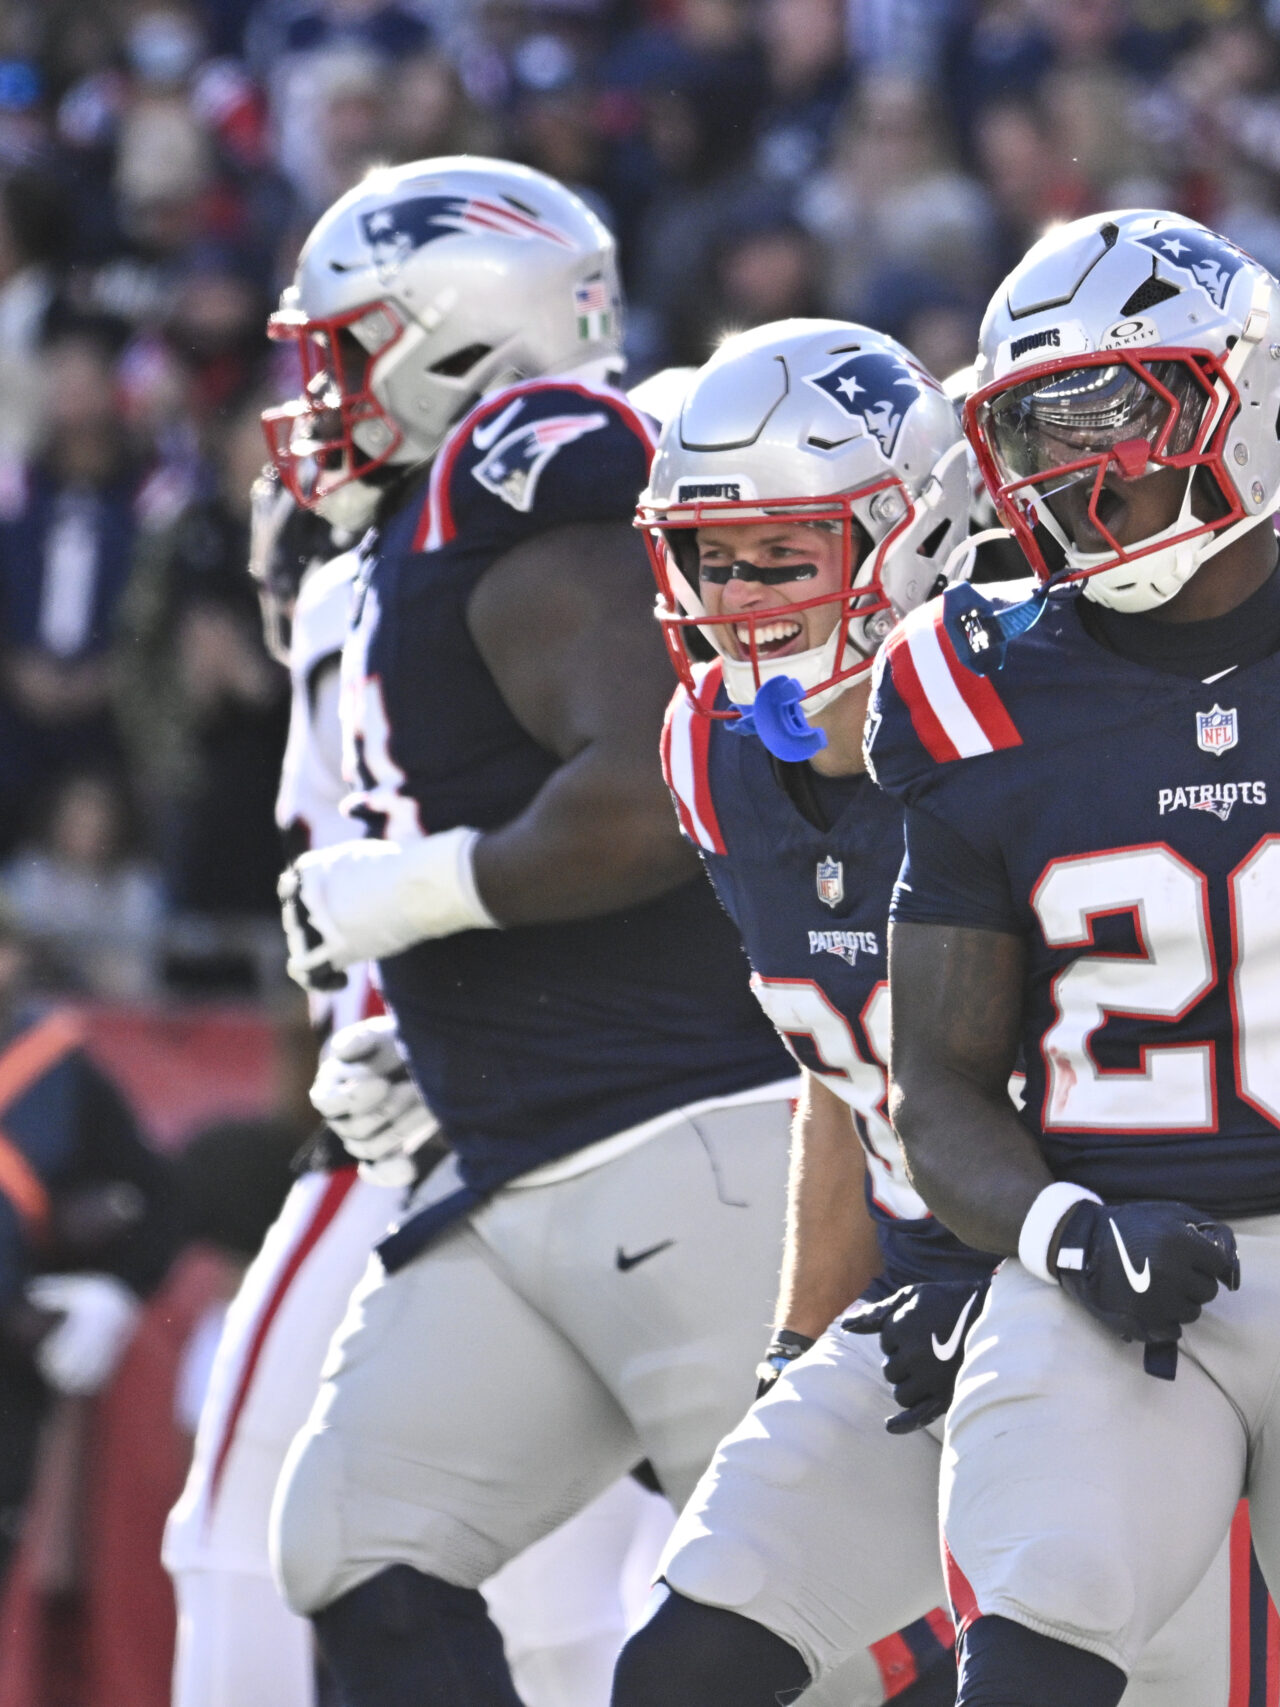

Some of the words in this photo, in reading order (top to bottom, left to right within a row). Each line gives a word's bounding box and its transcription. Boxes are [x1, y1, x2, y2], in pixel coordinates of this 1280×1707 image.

[1105, 328, 1155, 351] OAKLEY
[1204, 726, 1231, 745] NFL
[1158, 780, 1268, 815] PATRIOTS
[807, 929, 879, 955] PATRIOTS
